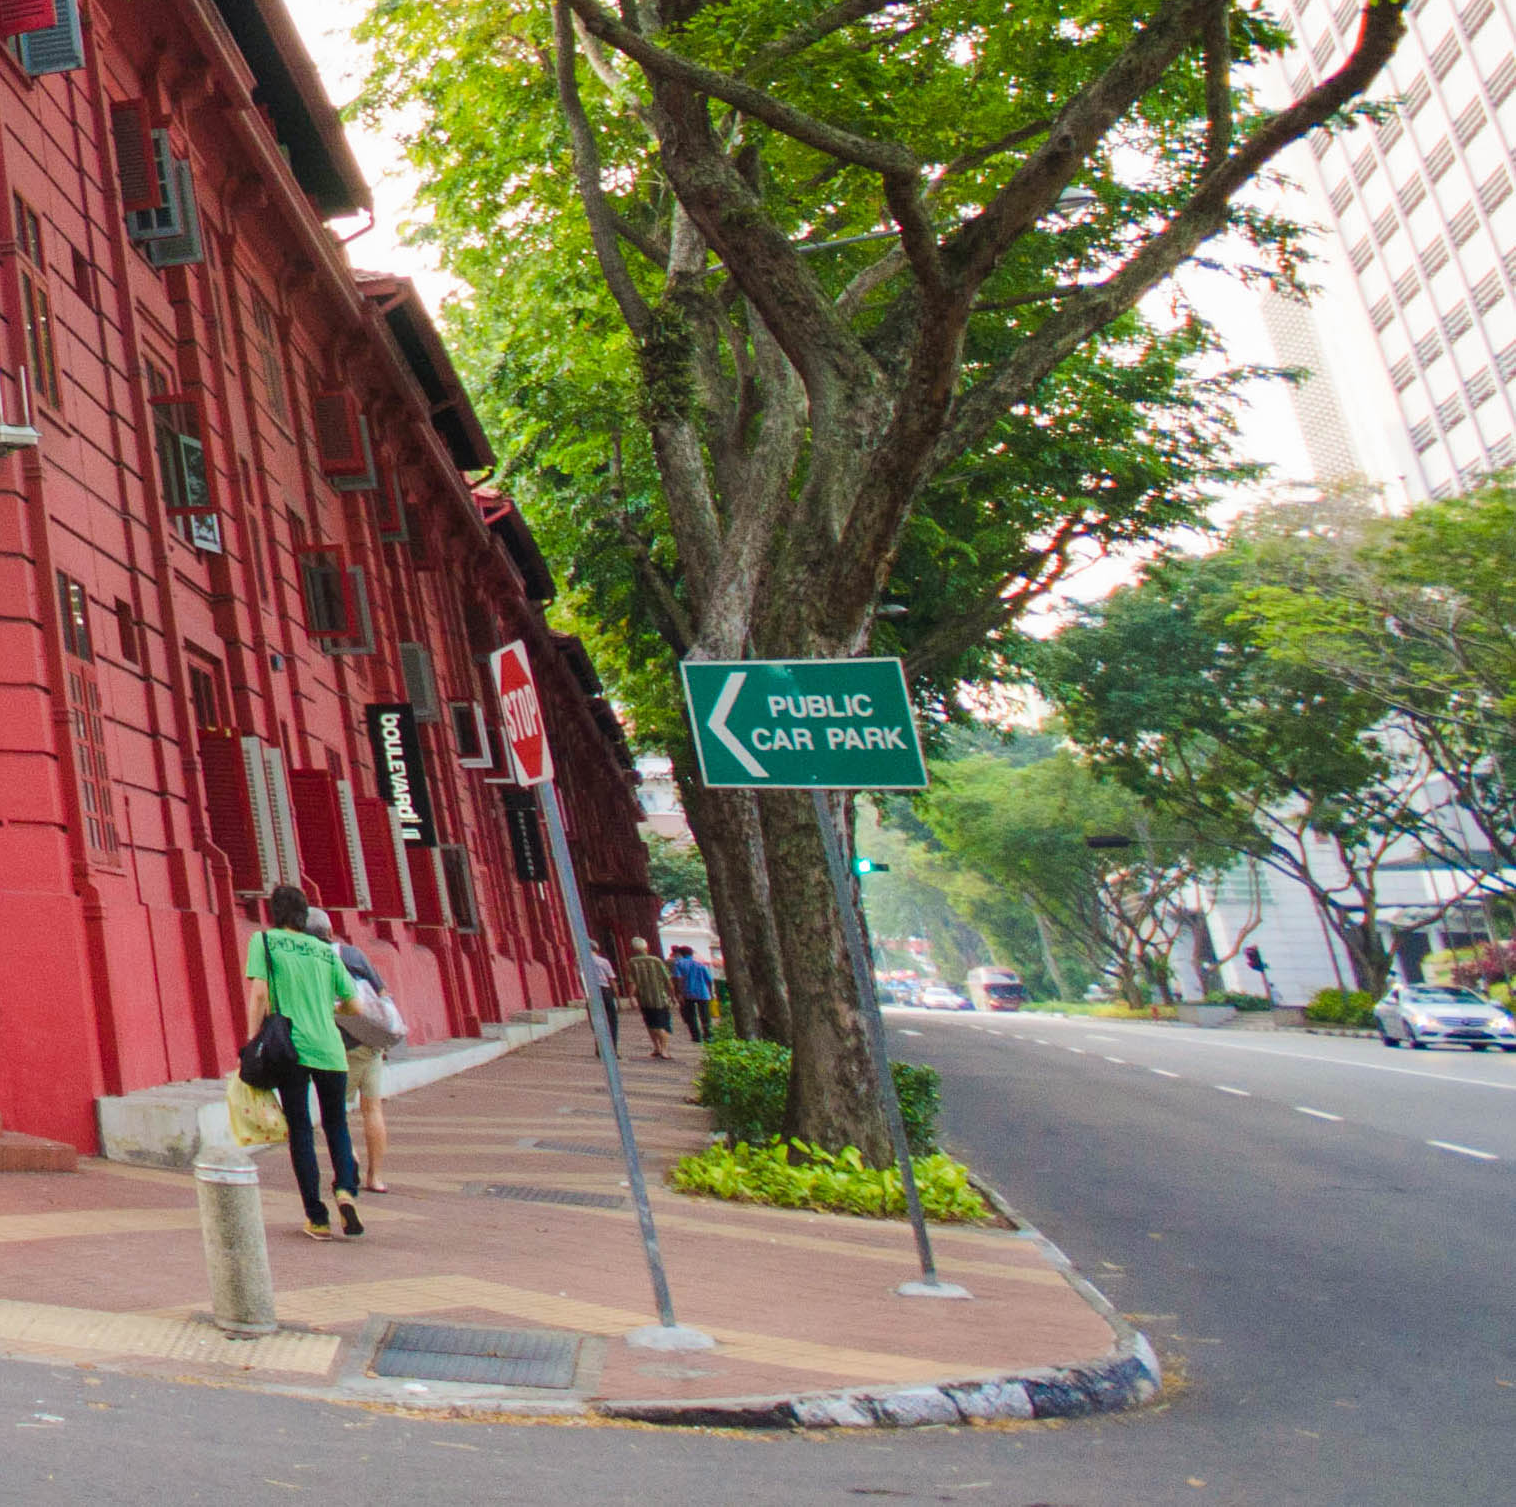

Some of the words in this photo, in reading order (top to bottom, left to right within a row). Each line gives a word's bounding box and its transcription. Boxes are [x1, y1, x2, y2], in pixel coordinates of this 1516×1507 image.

[502, 683, 539, 743] STOP
[767, 693, 874, 719] PUBLIC
[750, 727, 815, 751] CAR
[825, 726, 909, 751] PARK
